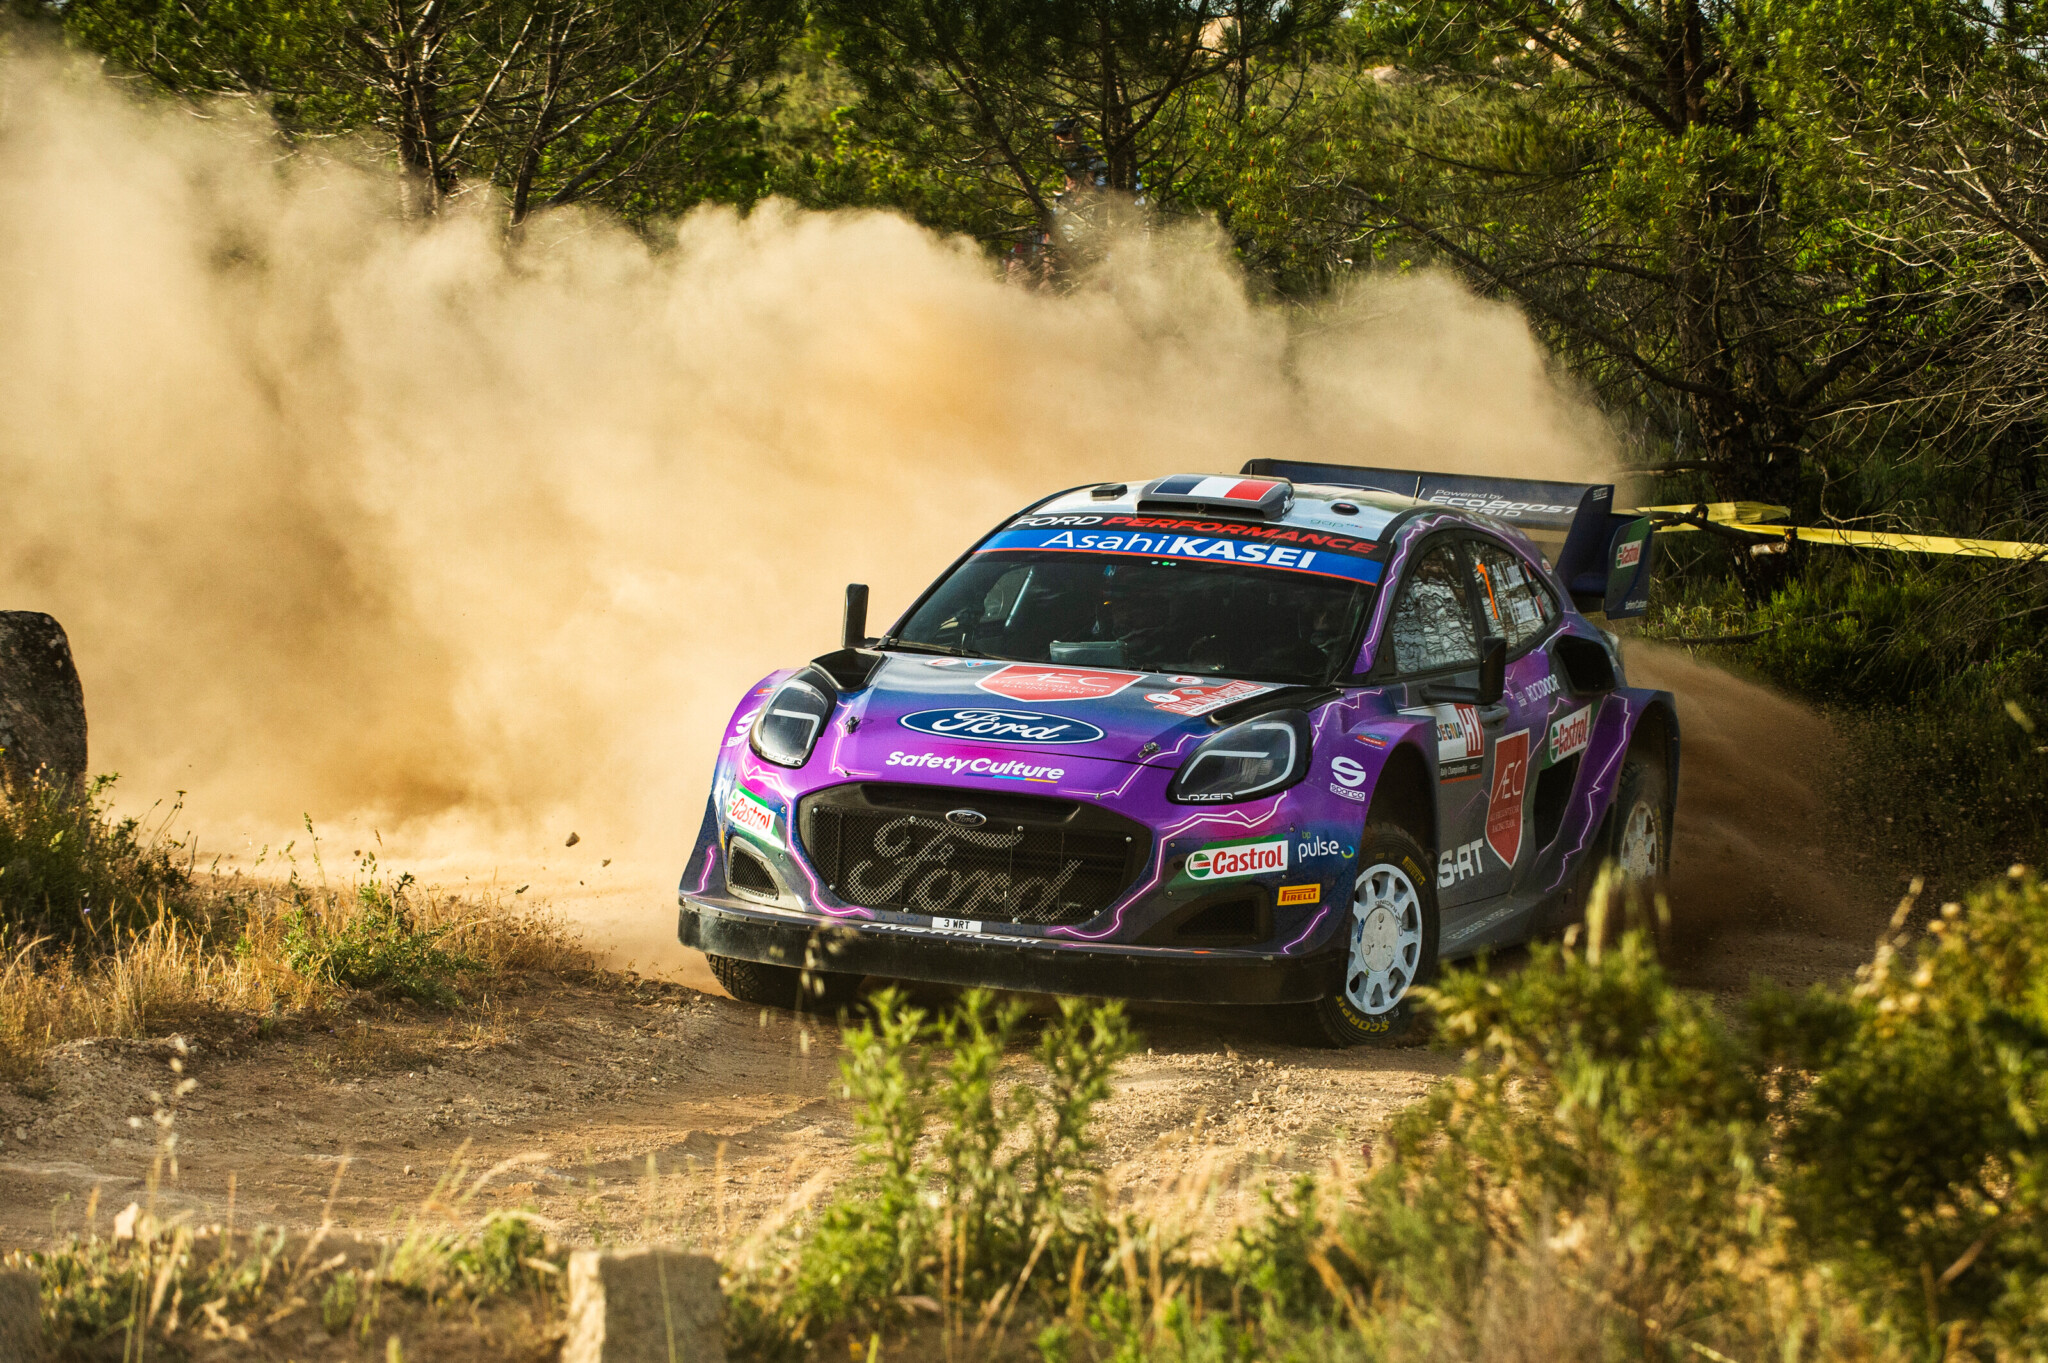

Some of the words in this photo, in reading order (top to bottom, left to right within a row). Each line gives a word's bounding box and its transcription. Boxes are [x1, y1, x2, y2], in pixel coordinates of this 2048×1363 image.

[1430, 496, 1578, 514] ECOBOOST
[1435, 489, 1488, 499] Powered
[1008, 516, 1103, 528] FORD
[1102, 517, 1379, 554] PERFORMANCE
[1039, 531, 1317, 569] AsahiKASEI
[1002, 672, 1111, 688] AEC
[932, 710, 1071, 739] Ford
[1559, 711, 1588, 755] Castrol
[885, 751, 1065, 779] SafetyCulture
[1331, 784, 1364, 800] sparco
[1493, 760, 1521, 804] AEC
[731, 798, 772, 830] Castrol
[954, 812, 978, 824] Ford
[1302, 830, 1311, 839] bp
[1213, 845, 1284, 875] Castrol
[1298, 836, 1339, 863] pulse
[848, 817, 1083, 923] Ford
[1281, 888, 1317, 902] PIRELLI
[944, 918, 950, 928] 3
[953, 919, 972, 930] WRT
